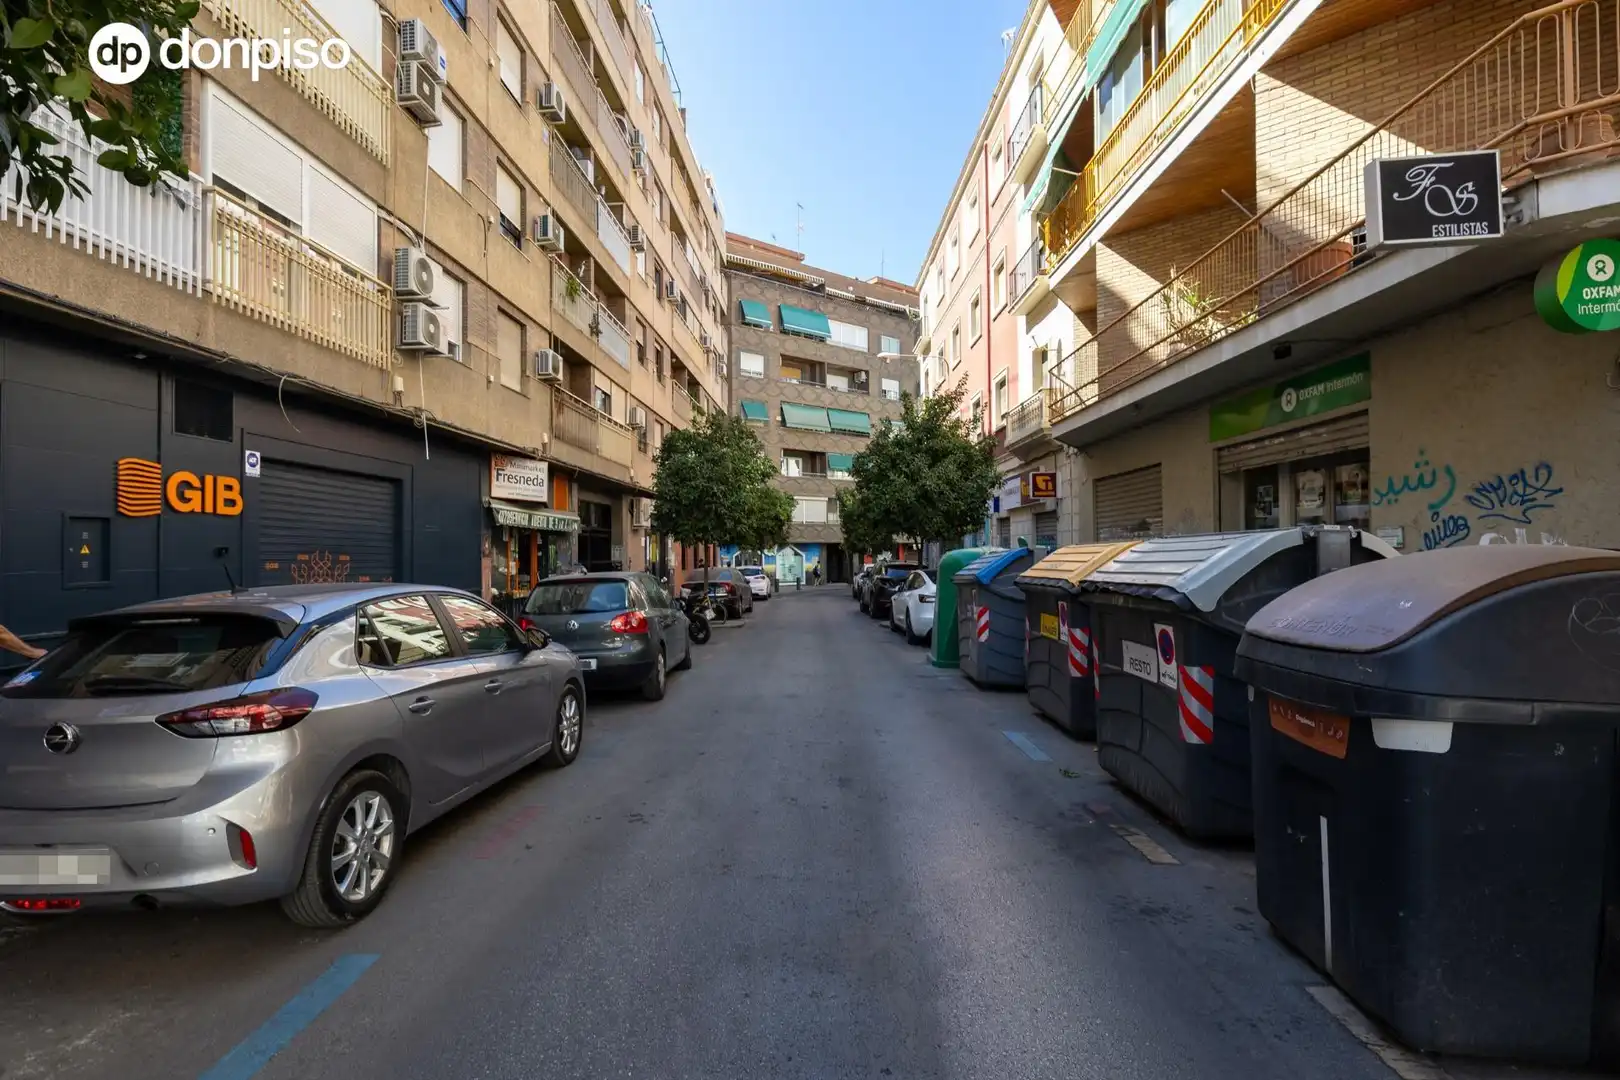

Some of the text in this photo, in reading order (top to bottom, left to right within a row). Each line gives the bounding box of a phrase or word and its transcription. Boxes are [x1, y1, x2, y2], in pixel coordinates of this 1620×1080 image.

[1432, 221, 1489, 237] ESTILISTAS
[1582, 284, 1620, 300] OXFAM
[1299, 382, 1325, 401] OXFAM
[509, 460, 545, 474] Minimarket
[495, 467, 545, 488] Fresneda
[165, 470, 244, 516] GIB
[1129, 657, 1152, 675] RESTO
